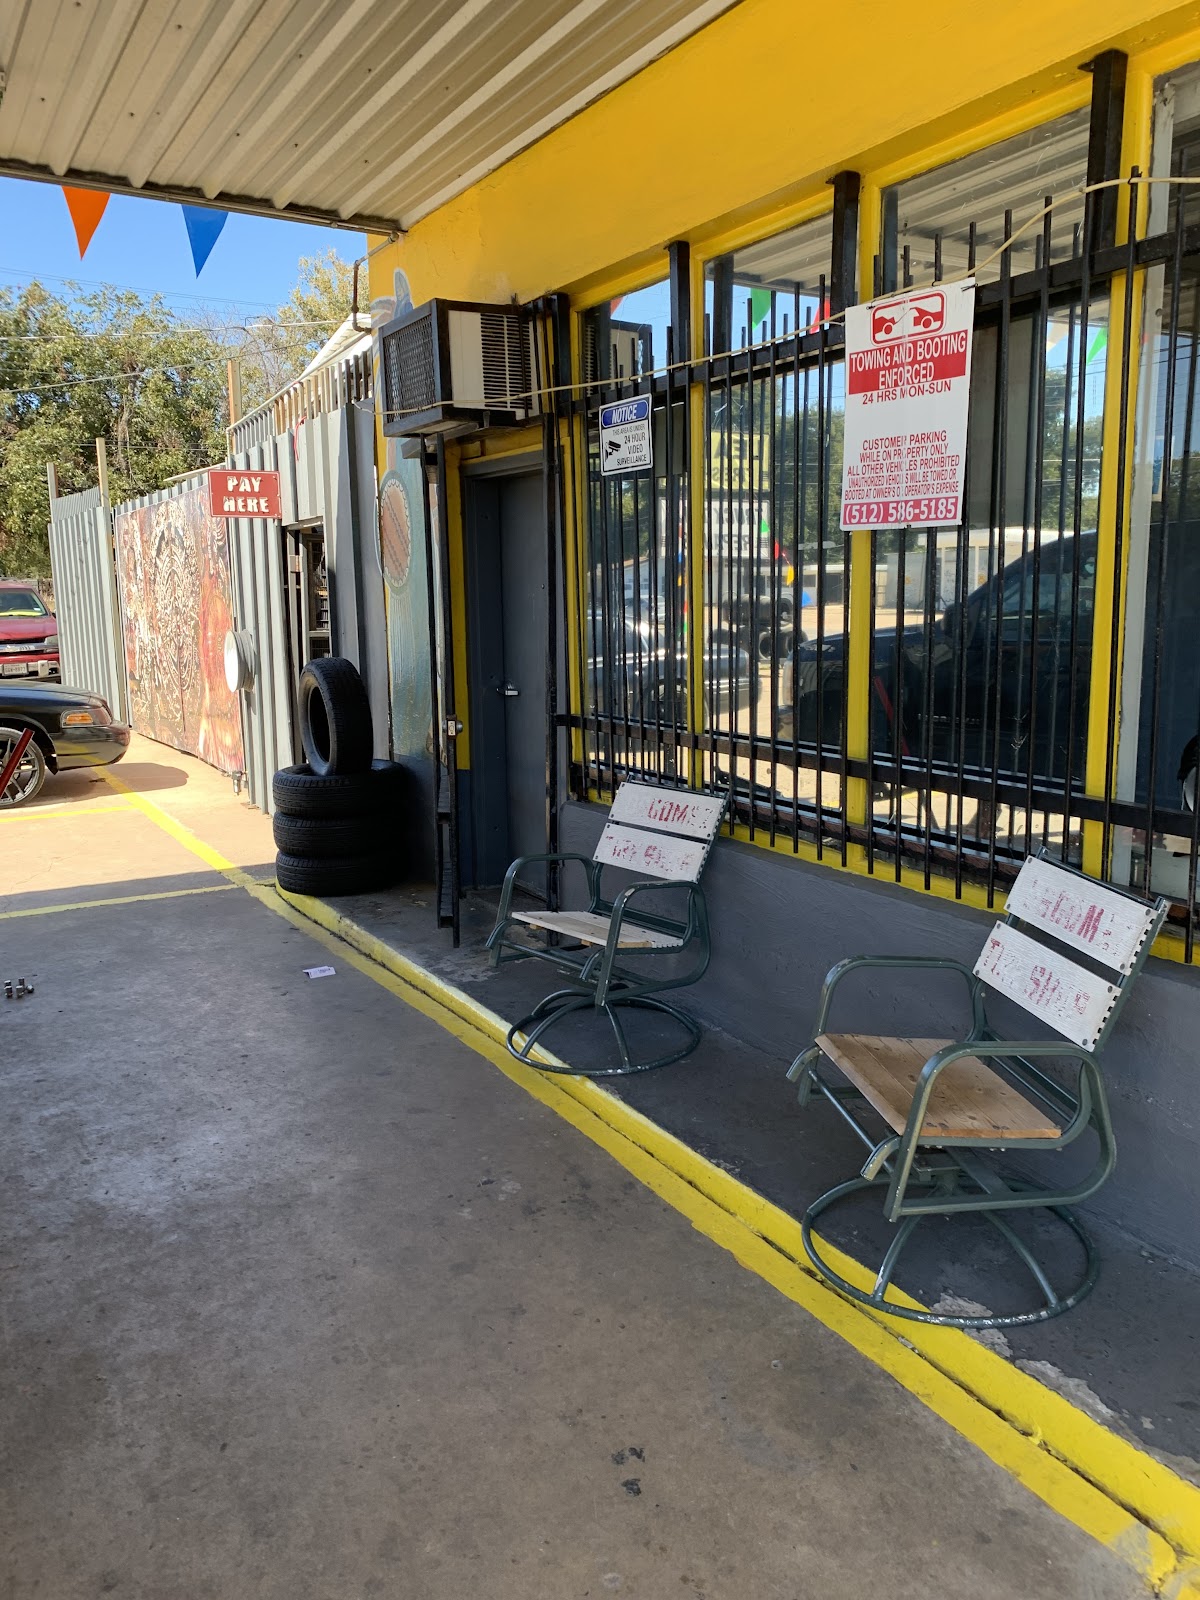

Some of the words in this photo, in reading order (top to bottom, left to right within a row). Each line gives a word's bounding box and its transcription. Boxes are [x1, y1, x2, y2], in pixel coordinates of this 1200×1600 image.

[850, 346, 891, 373] TOWING
[892, 343, 914, 365] AND
[916, 332, 967, 361] BOOTING
[878, 361, 935, 390] ENFORCED
[862, 393, 874, 405] 24
[877, 389, 897, 403] HRS
[899, 380, 952, 399] MON-SUN
[611, 404, 638, 424] NOTICE
[612, 428, 620, 436] THIS
[620, 427, 629, 435] AREA
[633, 424, 646, 432] UNDER
[624, 435, 631, 444] 24
[632, 432, 646, 443] HOUR
[627, 444, 643, 455] VIDEO
[862, 435, 907, 451] CUSTOMER
[909, 430, 947, 446] PARKING
[617, 454, 647, 466] SURVEILLANCE
[860, 450, 881, 463] WHILE
[882, 450, 892, 461] ON
[930, 443, 949, 456] ONLY
[847, 466, 860, 477] ALL
[861, 462, 884, 474] OTHER
[919, 455, 960, 470] PROHIBITED
[227, 476, 262, 492] PAY
[848, 475, 885, 489] UNAUTHORIZED
[909, 472, 922, 484] WILL
[922, 471, 930, 482] BE
[930, 469, 948, 482] TOWED
[949, 468, 957, 480] OR
[844, 488, 865, 501] BOOTED
[865, 487, 872, 499] AT
[873, 486, 896, 499] OWNER'S
[904, 483, 935, 497] OPERATOR'S
[936, 481, 959, 495] EXPENSE
[223, 496, 270, 513] HERE
[845, 503, 884, 524] (512)
[887, 498, 956, 522] 586-5185
